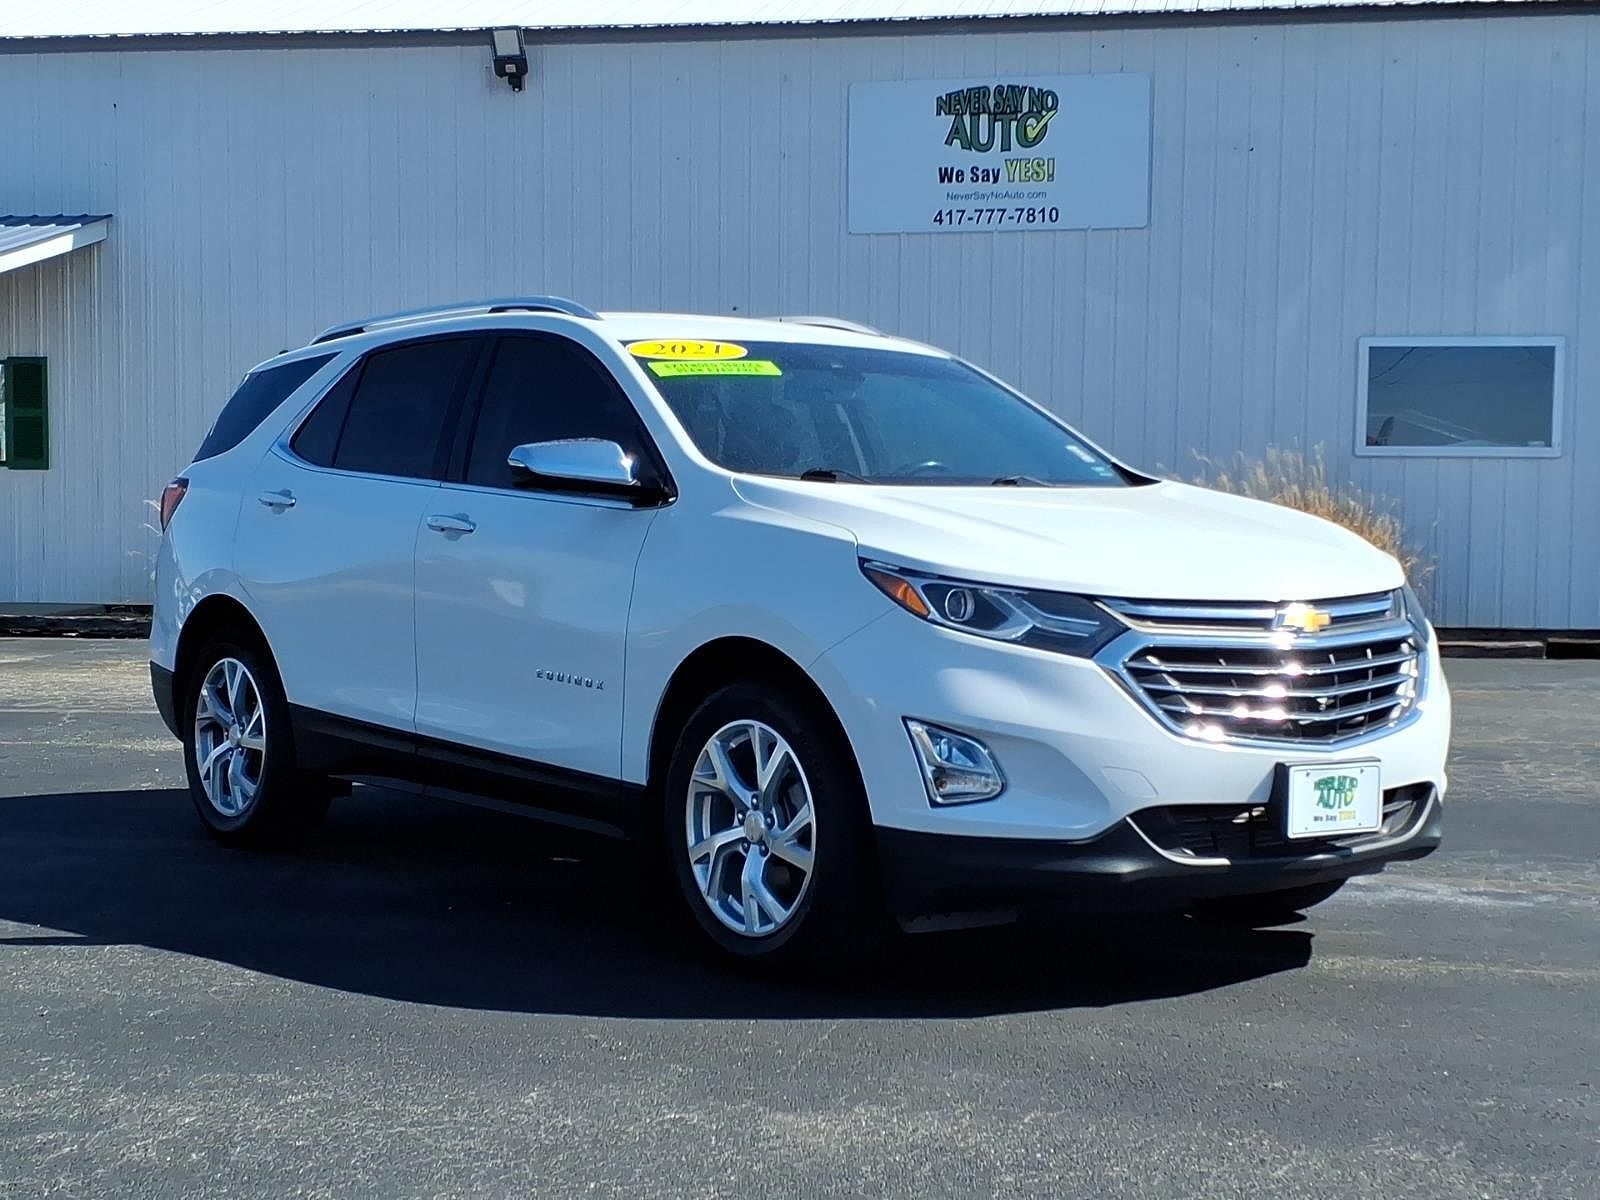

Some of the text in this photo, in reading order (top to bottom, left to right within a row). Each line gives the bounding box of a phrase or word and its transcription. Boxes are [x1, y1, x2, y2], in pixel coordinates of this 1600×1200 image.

[936, 84, 1059, 116] NEVER SAY NO
[944, 112, 1048, 153] AUTO
[938, 157, 1056, 184] We Say YES!
[946, 190, 1047, 202] NeverSayNoAuto.com
[933, 207, 1060, 226] 417-777-7810
[654, 344, 721, 355] 2021
[536, 668, 604, 690] EQUINOX
[1316, 789, 1354, 809] AUTO
